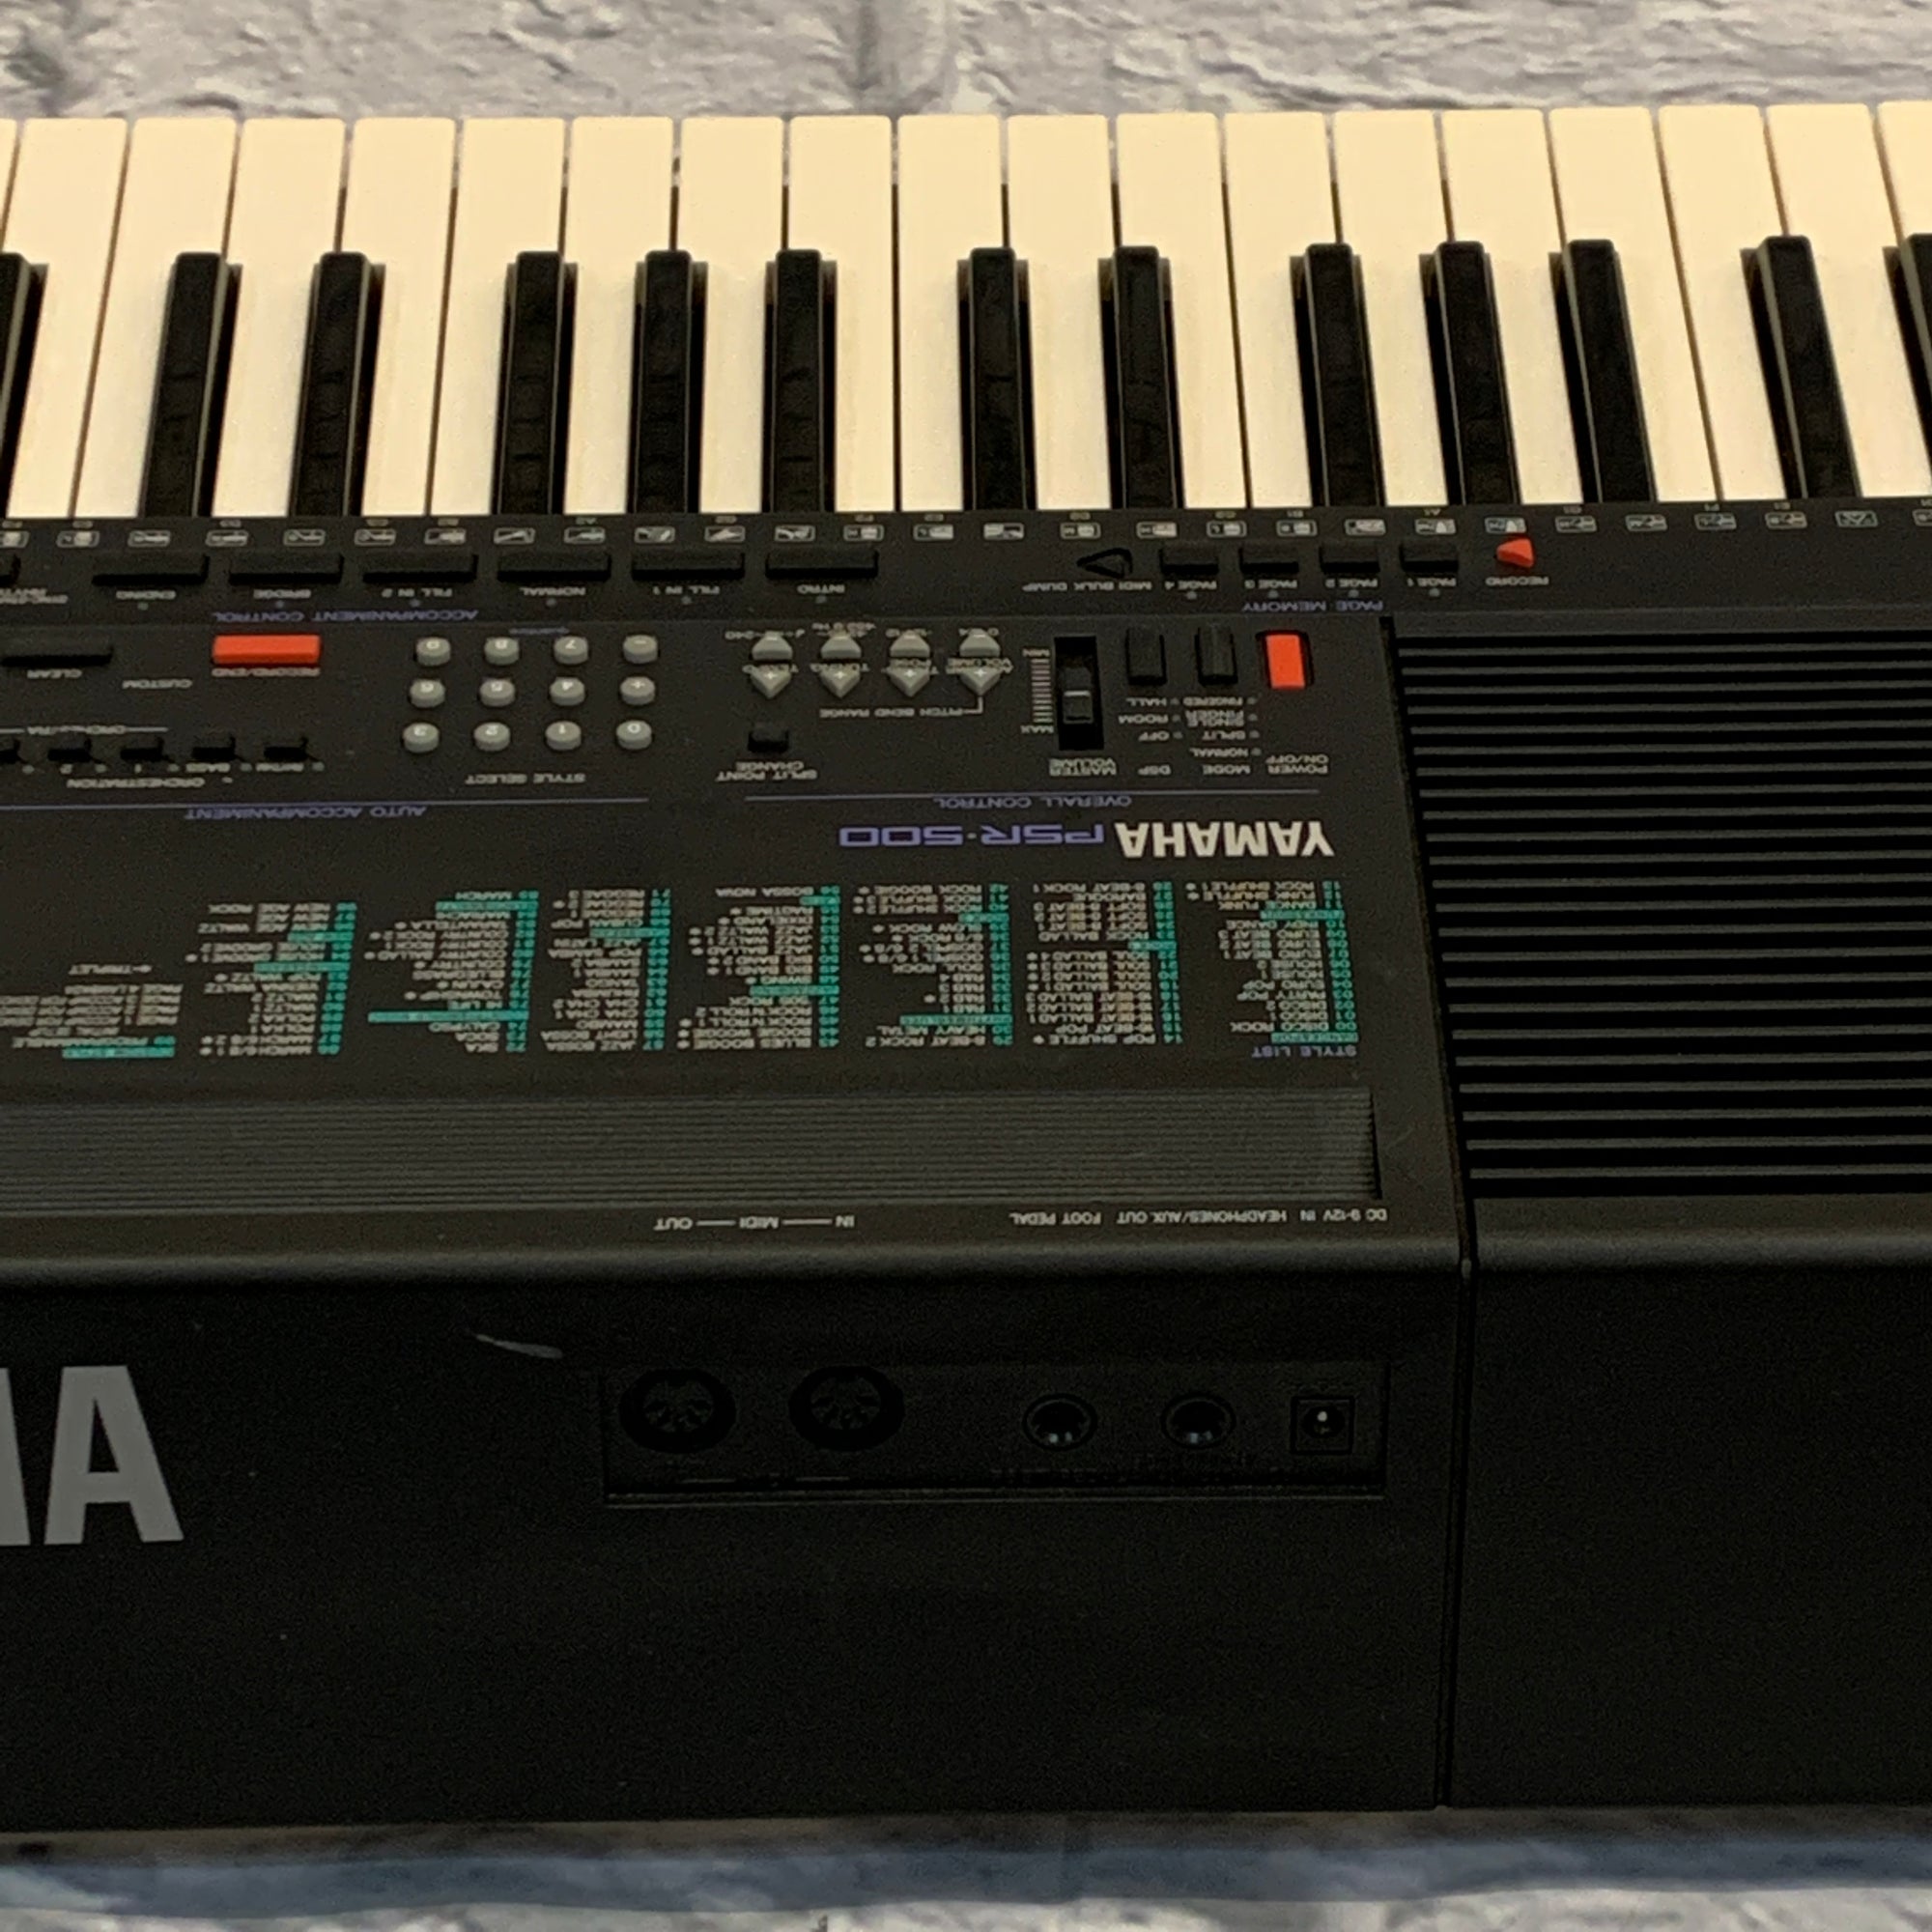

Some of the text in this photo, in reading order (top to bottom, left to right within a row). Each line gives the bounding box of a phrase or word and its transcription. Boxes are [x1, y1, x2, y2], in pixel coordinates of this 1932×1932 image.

[1179, 580, 1217, 589] PAGE
[1258, 580, 1296, 588] PAGE
[1339, 578, 1378, 587] PAGE
[1406, 578, 1456, 587] PAGE 1
[1486, 576, 1549, 585] RECORD
[519, 586, 585, 595] NORMAL
[652, 585, 720, 595] FILL IN 1
[796, 583, 845, 593] INTRO
[1022, 582, 1151, 591] MIDI BULK DUMP
[116, 590, 176, 599] ENDING
[253, 589, 311, 599] BRIDGE
[398, 587, 415, 597] IN
[421, 587, 452, 597] FILL
[1241, 600, 1383, 612] PAGE MEMORY
[213, 610, 479, 622] ACCOMPANIMENT CONTROL
[1022, 648, 1050, 657] MIN
[27, 668, 82, 678] CLEAR
[122, 679, 191, 690] CUSTOM
[1125, 697, 1167, 706] HALL
[1182, 696, 1242, 706] FINGERED
[819, 707, 962, 718] PITCH BEND RANGE
[1184, 709, 1244, 719] FINGER
[1118, 715, 1169, 724] ROOM
[1020, 724, 1054, 734] MAX
[1138, 730, 1170, 741] OFF
[1202, 730, 1246, 740] SPLIT
[1189, 748, 1248, 757] NORMAL
[1049, 757, 1116, 767] VOLUME
[1265, 753, 1329, 764] ON/OFF
[185, 763, 230, 773] BASS
[735, 761, 804, 771] CHANGE
[1138, 764, 1171, 775] DSP
[1202, 764, 1251, 775] MODE
[1267, 764, 1328, 774] POWER
[715, 770, 817, 781] SPLIT POINT
[1049, 767, 1117, 777] MASTER
[67, 777, 205, 788] ORCHESTRATION
[465, 773, 585, 784] STYLE SELECT
[933, 796, 1132, 810] OVERALL CONTROL
[184, 806, 427, 819] AUTO ACCOMPANIMENT
[1114, 821, 1335, 858] YAMAHA
[939, 884, 981, 894] ROCK
[1042, 883, 1087, 893] ROCK
[1210, 881, 1314, 891] ROCK SHUFFLE
[454, 891, 512, 900] MARCH
[715, 887, 813, 897] BOSSA NOVA
[1072, 892, 1146, 900] BAROQUE
[207, 904, 254, 914] ROCK
[1217, 900, 1317, 910] DANCE FUNK
[889, 923, 932, 933] ROCK
[1037, 931, 1150, 941] ROCK BALLAD
[1232, 929, 1271, 939] BEAT
[706, 945, 812, 955] JAZZ BALLAD
[1233, 950, 1273, 960] BEAT
[1278, 950, 1321, 959] EURO
[68, 964, 132, 976] TRIPLET
[892, 963, 937, 974] ROCK
[1053, 981, 1109, 991] BALLAD
[1242, 980, 1324, 990] EURO POP
[1236, 990, 1327, 1001] PARTY POP
[1037, 1003, 1094, 1012] BALLAD
[1037, 1013, 1094, 1024] BALLAD
[876, 1025, 985, 1036] HEAVY METAL
[1229, 1021, 1275, 1033] ROCK
[759, 1037, 811, 1049] BLUES
[879, 1037, 924, 1047] ROCK
[1049, 1034, 1118, 1045] SHUFFLE
[1122, 1034, 1155, 1044] POP
[1251, 1045, 1357, 1058] STYLE LIST
[1010, 1211, 1101, 1225] FOOT PEDAL
[1117, 1210, 1148, 1223] OUT
[1300, 1209, 1387, 1221] DC 9-12V IN
[653, 1215, 855, 1231] IN MIDI OUT
